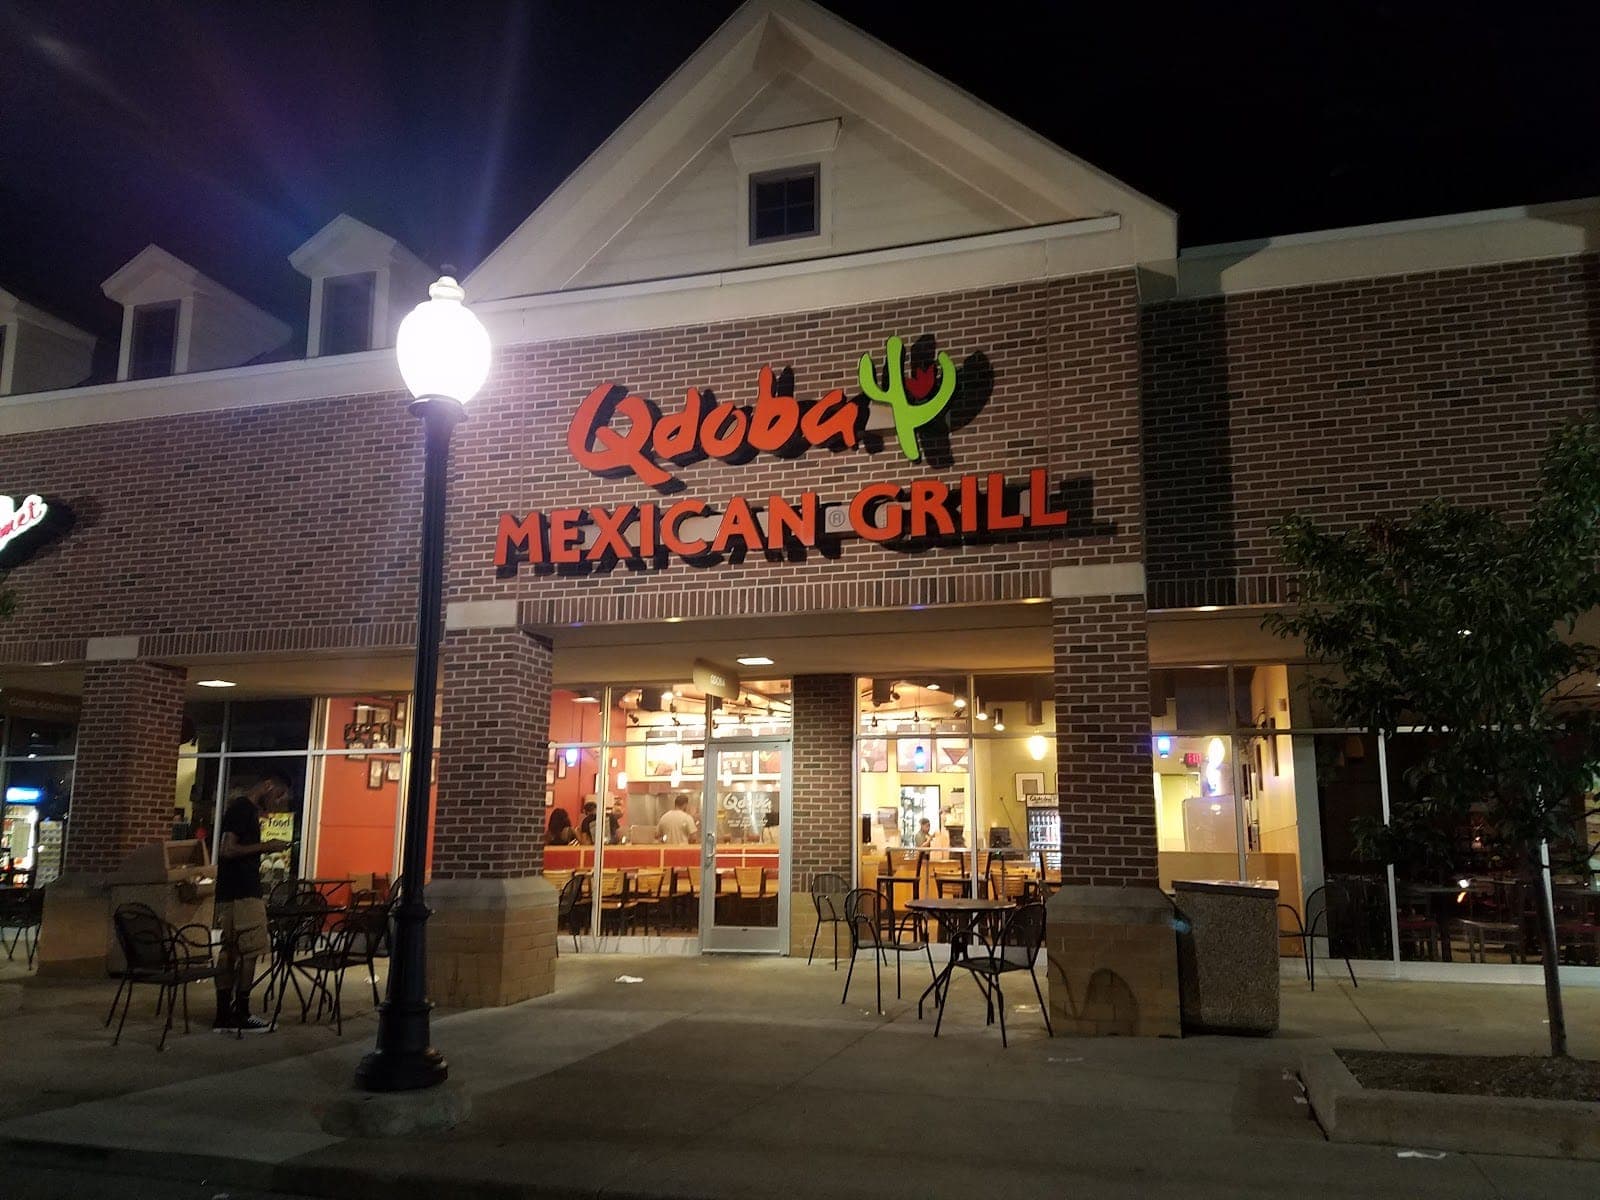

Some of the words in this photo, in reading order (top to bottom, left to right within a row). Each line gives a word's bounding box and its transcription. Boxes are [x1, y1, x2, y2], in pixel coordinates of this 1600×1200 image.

[566, 364, 860, 487] Qdoba
[493, 492, 818, 566] MEXICAN
[848, 468, 1069, 541] GRILL
